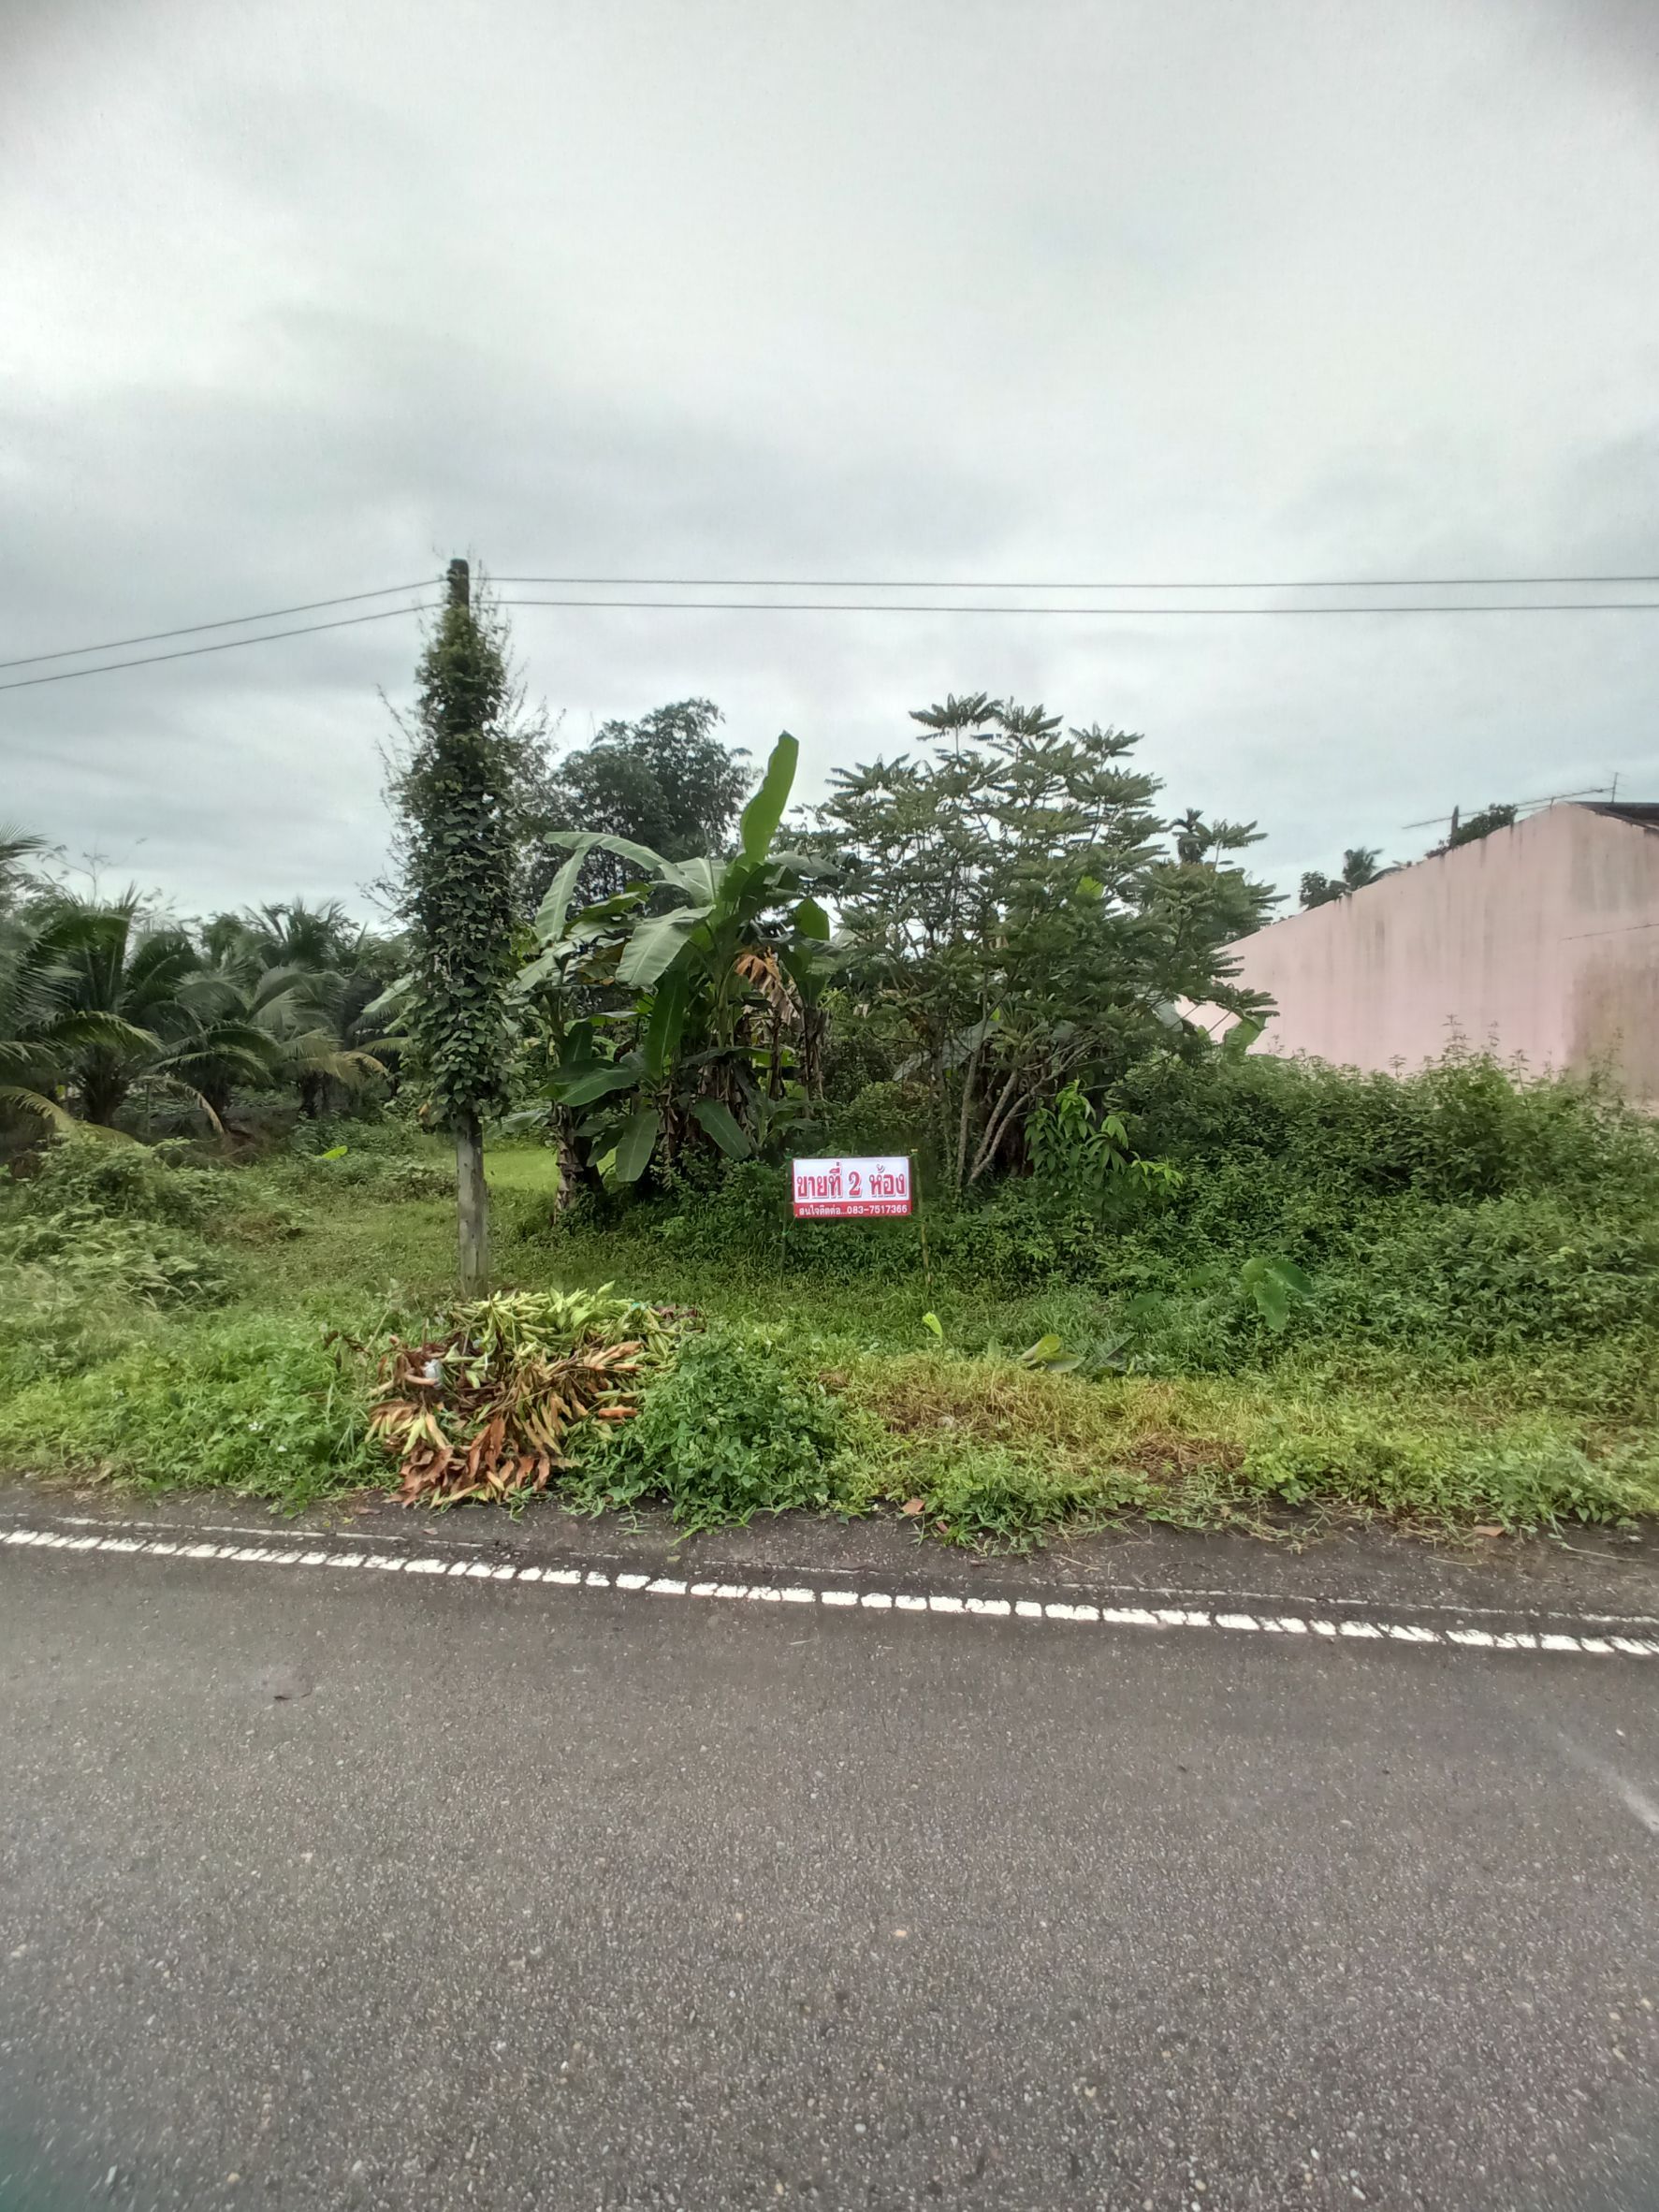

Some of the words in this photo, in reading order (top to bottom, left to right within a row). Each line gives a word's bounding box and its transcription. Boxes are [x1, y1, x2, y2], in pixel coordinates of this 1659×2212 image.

[796, 1161, 842, 1198] ขายที่
[849, 1171, 862, 1197] 2
[868, 1163, 906, 1197] ห้อง
